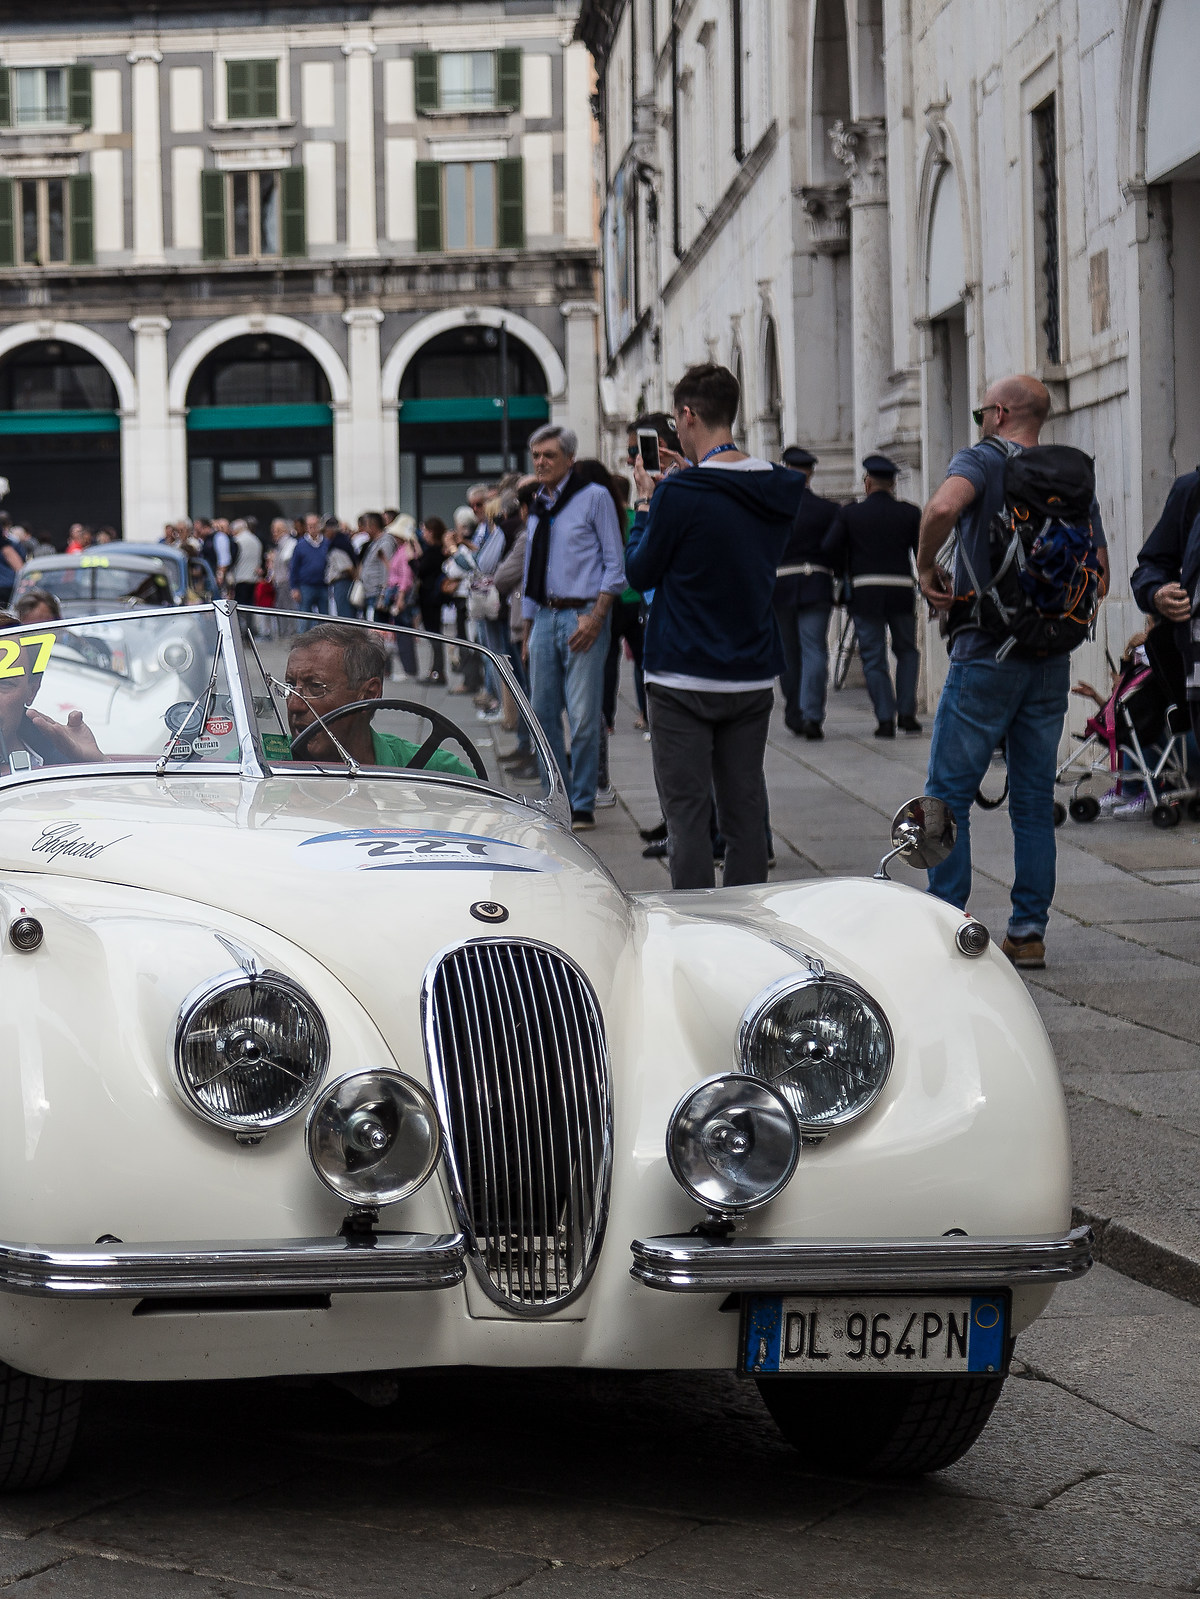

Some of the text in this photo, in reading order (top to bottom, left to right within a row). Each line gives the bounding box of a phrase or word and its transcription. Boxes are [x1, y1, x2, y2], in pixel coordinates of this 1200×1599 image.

[211, 723, 229, 731] 2015
[194, 741, 219, 750] VERIFICATO
[31, 820, 134, 864] Chopard
[354, 839, 489, 858] 227
[784, 1310, 830, 1360] DL
[845, 1311, 969, 1360] 964PN
